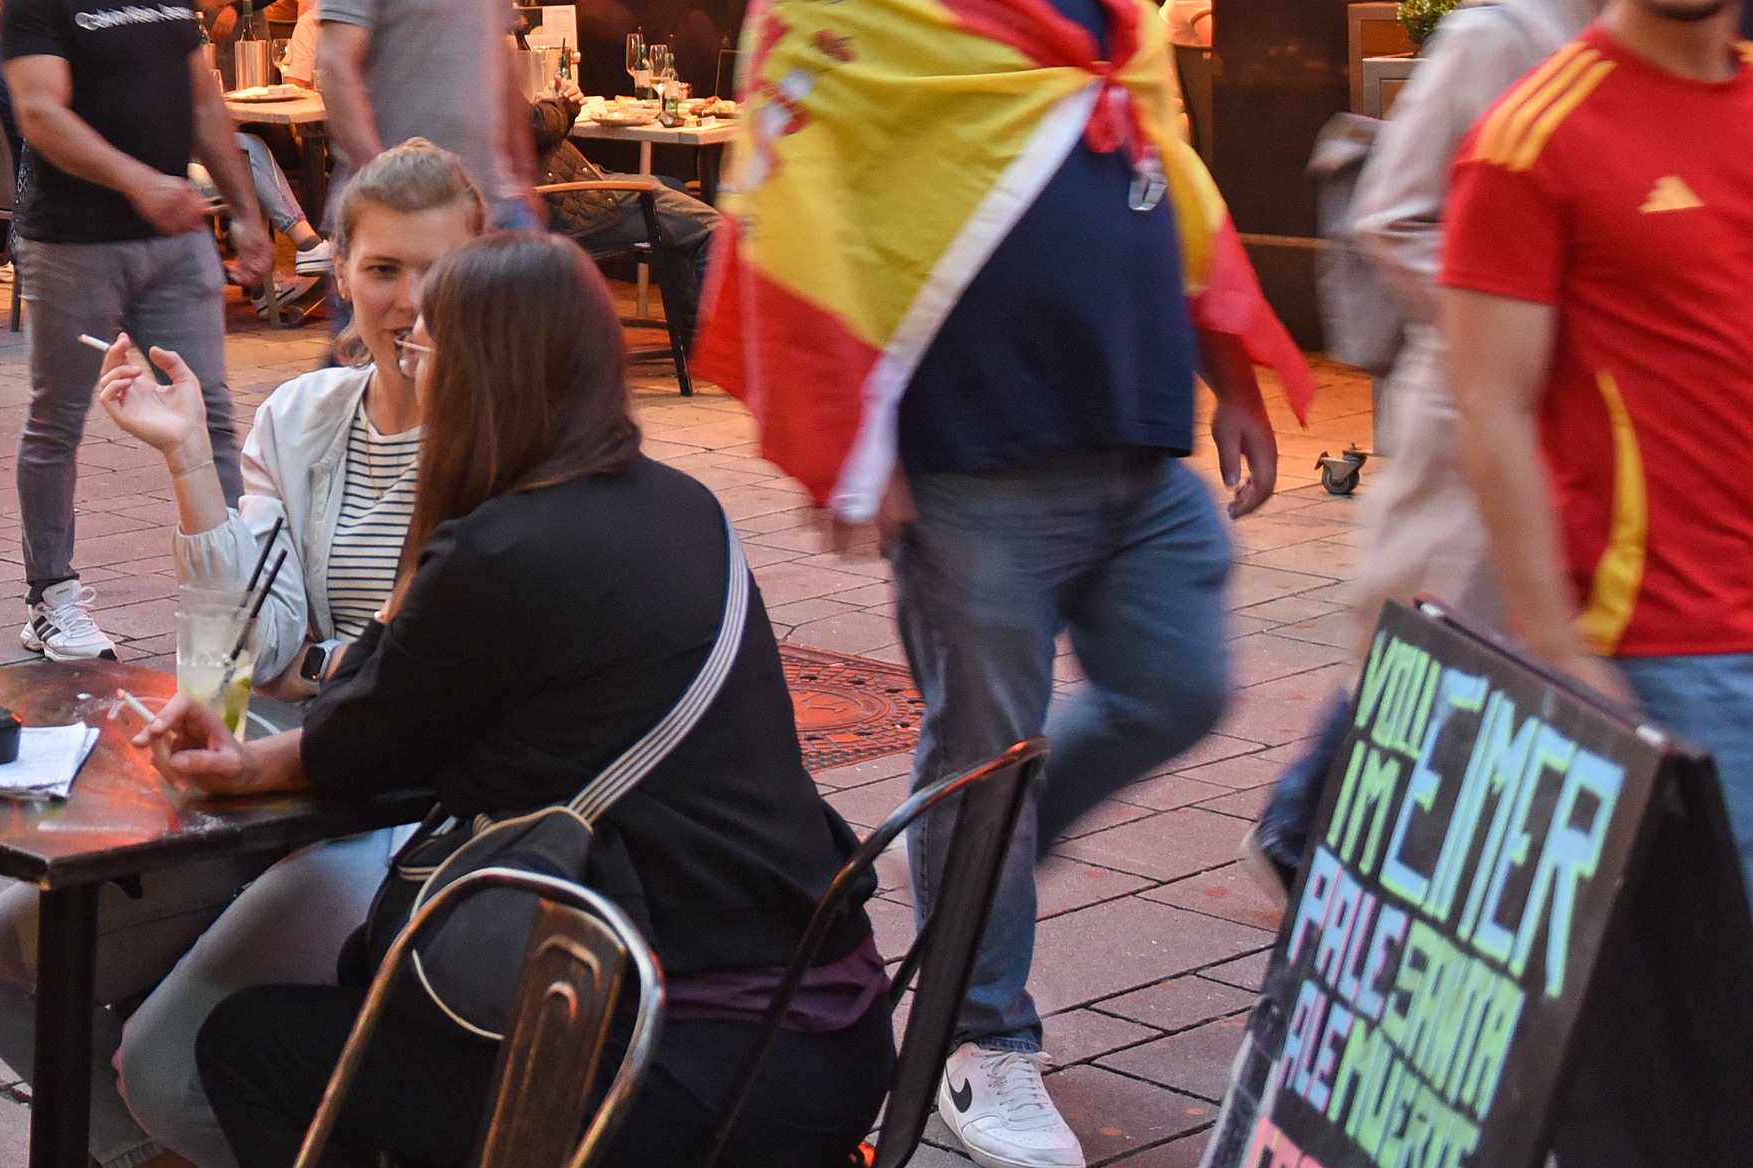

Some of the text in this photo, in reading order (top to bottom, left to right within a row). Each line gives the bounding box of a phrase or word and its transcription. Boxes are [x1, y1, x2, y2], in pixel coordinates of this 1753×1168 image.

[1354, 628, 1443, 761] VOLL
[1325, 739, 1401, 877] IM
[1379, 668, 1628, 1000] EIMER
[1286, 844, 1410, 1023] PALE
[1277, 977, 1355, 1114] ALE
